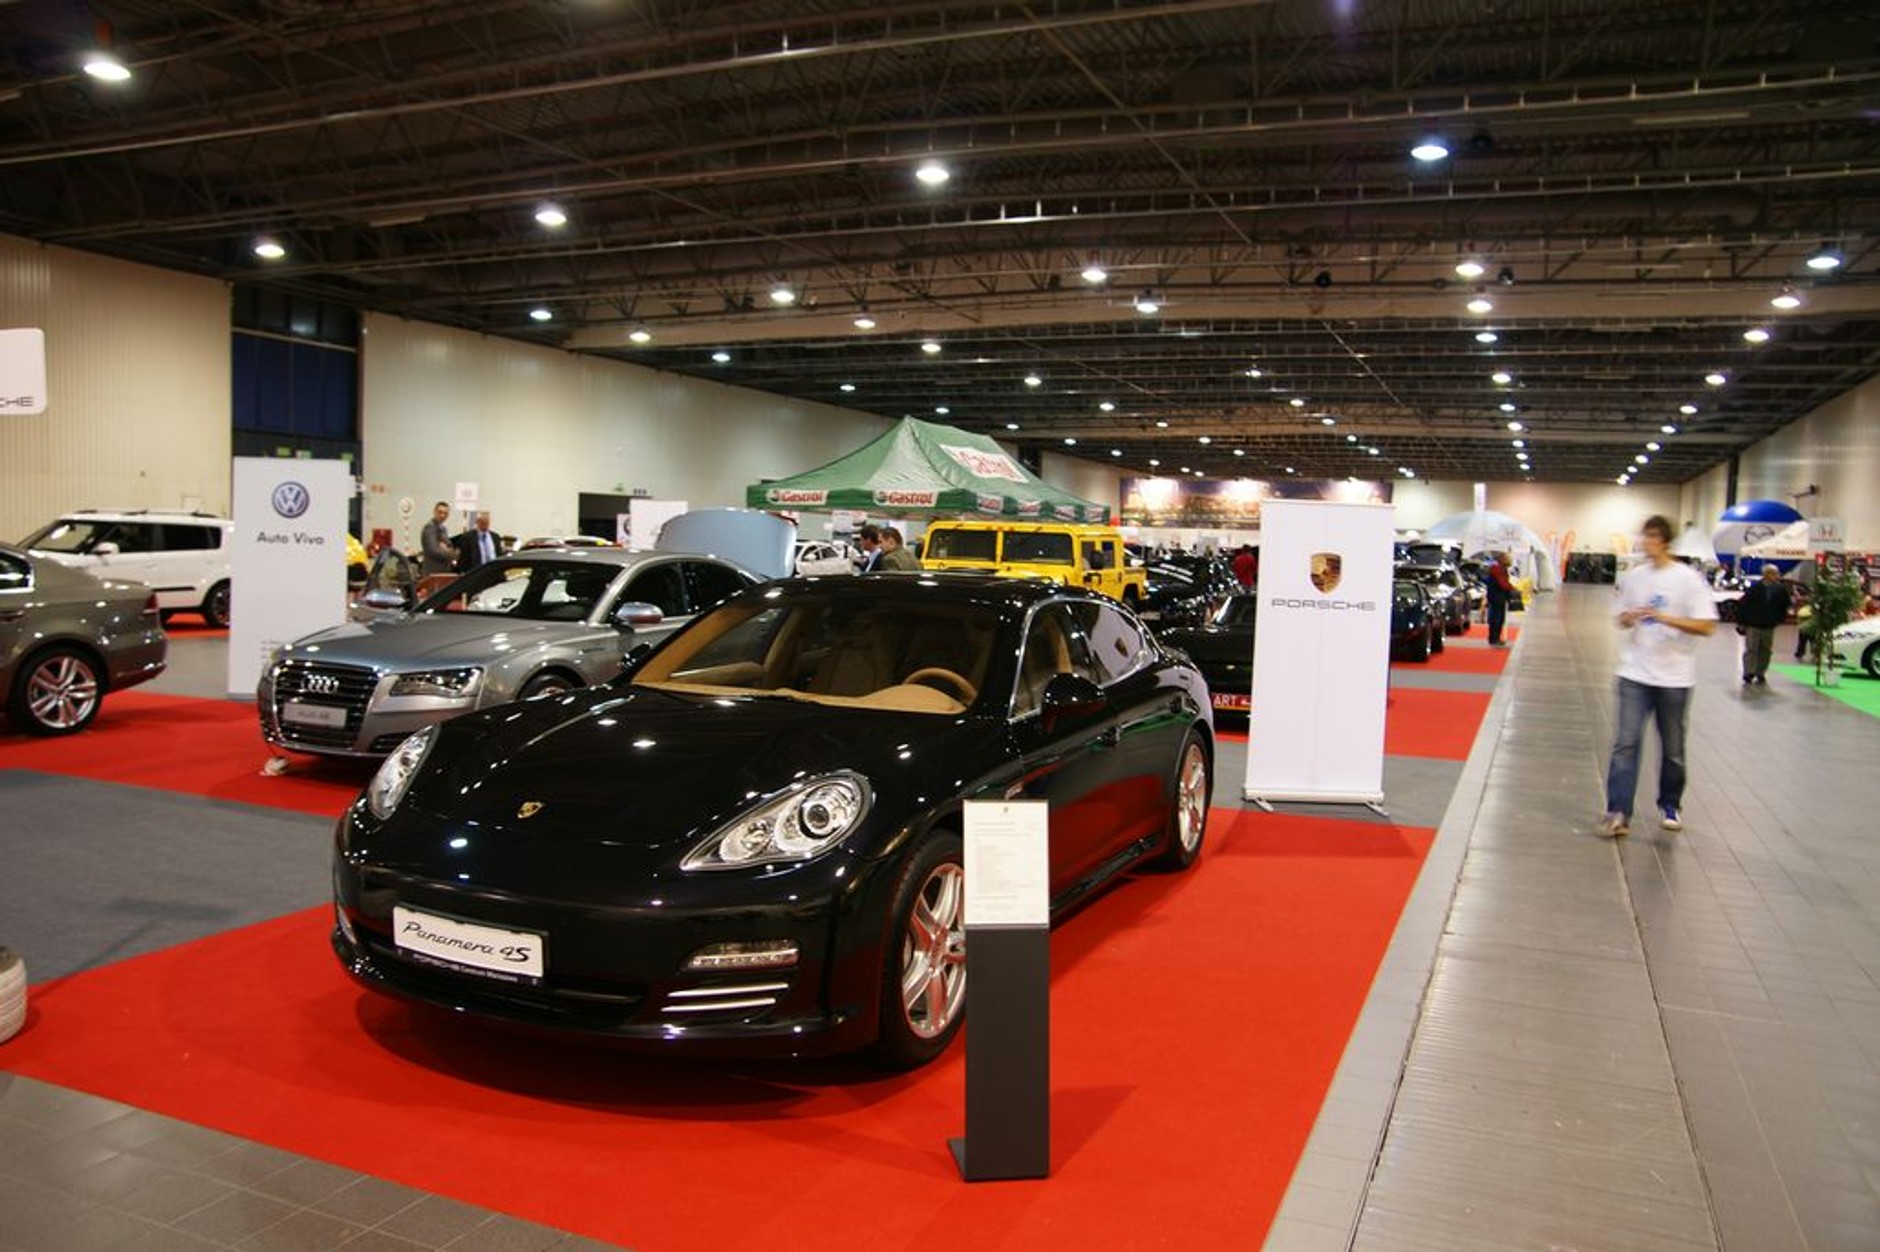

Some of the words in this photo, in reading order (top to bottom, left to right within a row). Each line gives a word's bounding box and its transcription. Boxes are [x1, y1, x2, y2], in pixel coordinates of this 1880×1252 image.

[781, 490, 823, 502] Castrol
[888, 491, 932, 504] Castrol
[257, 531, 289, 543] Auto
[1271, 598, 1376, 611] PORSCHE
[402, 921, 494, 954] Panamera
[499, 945, 532, 963] 4S
